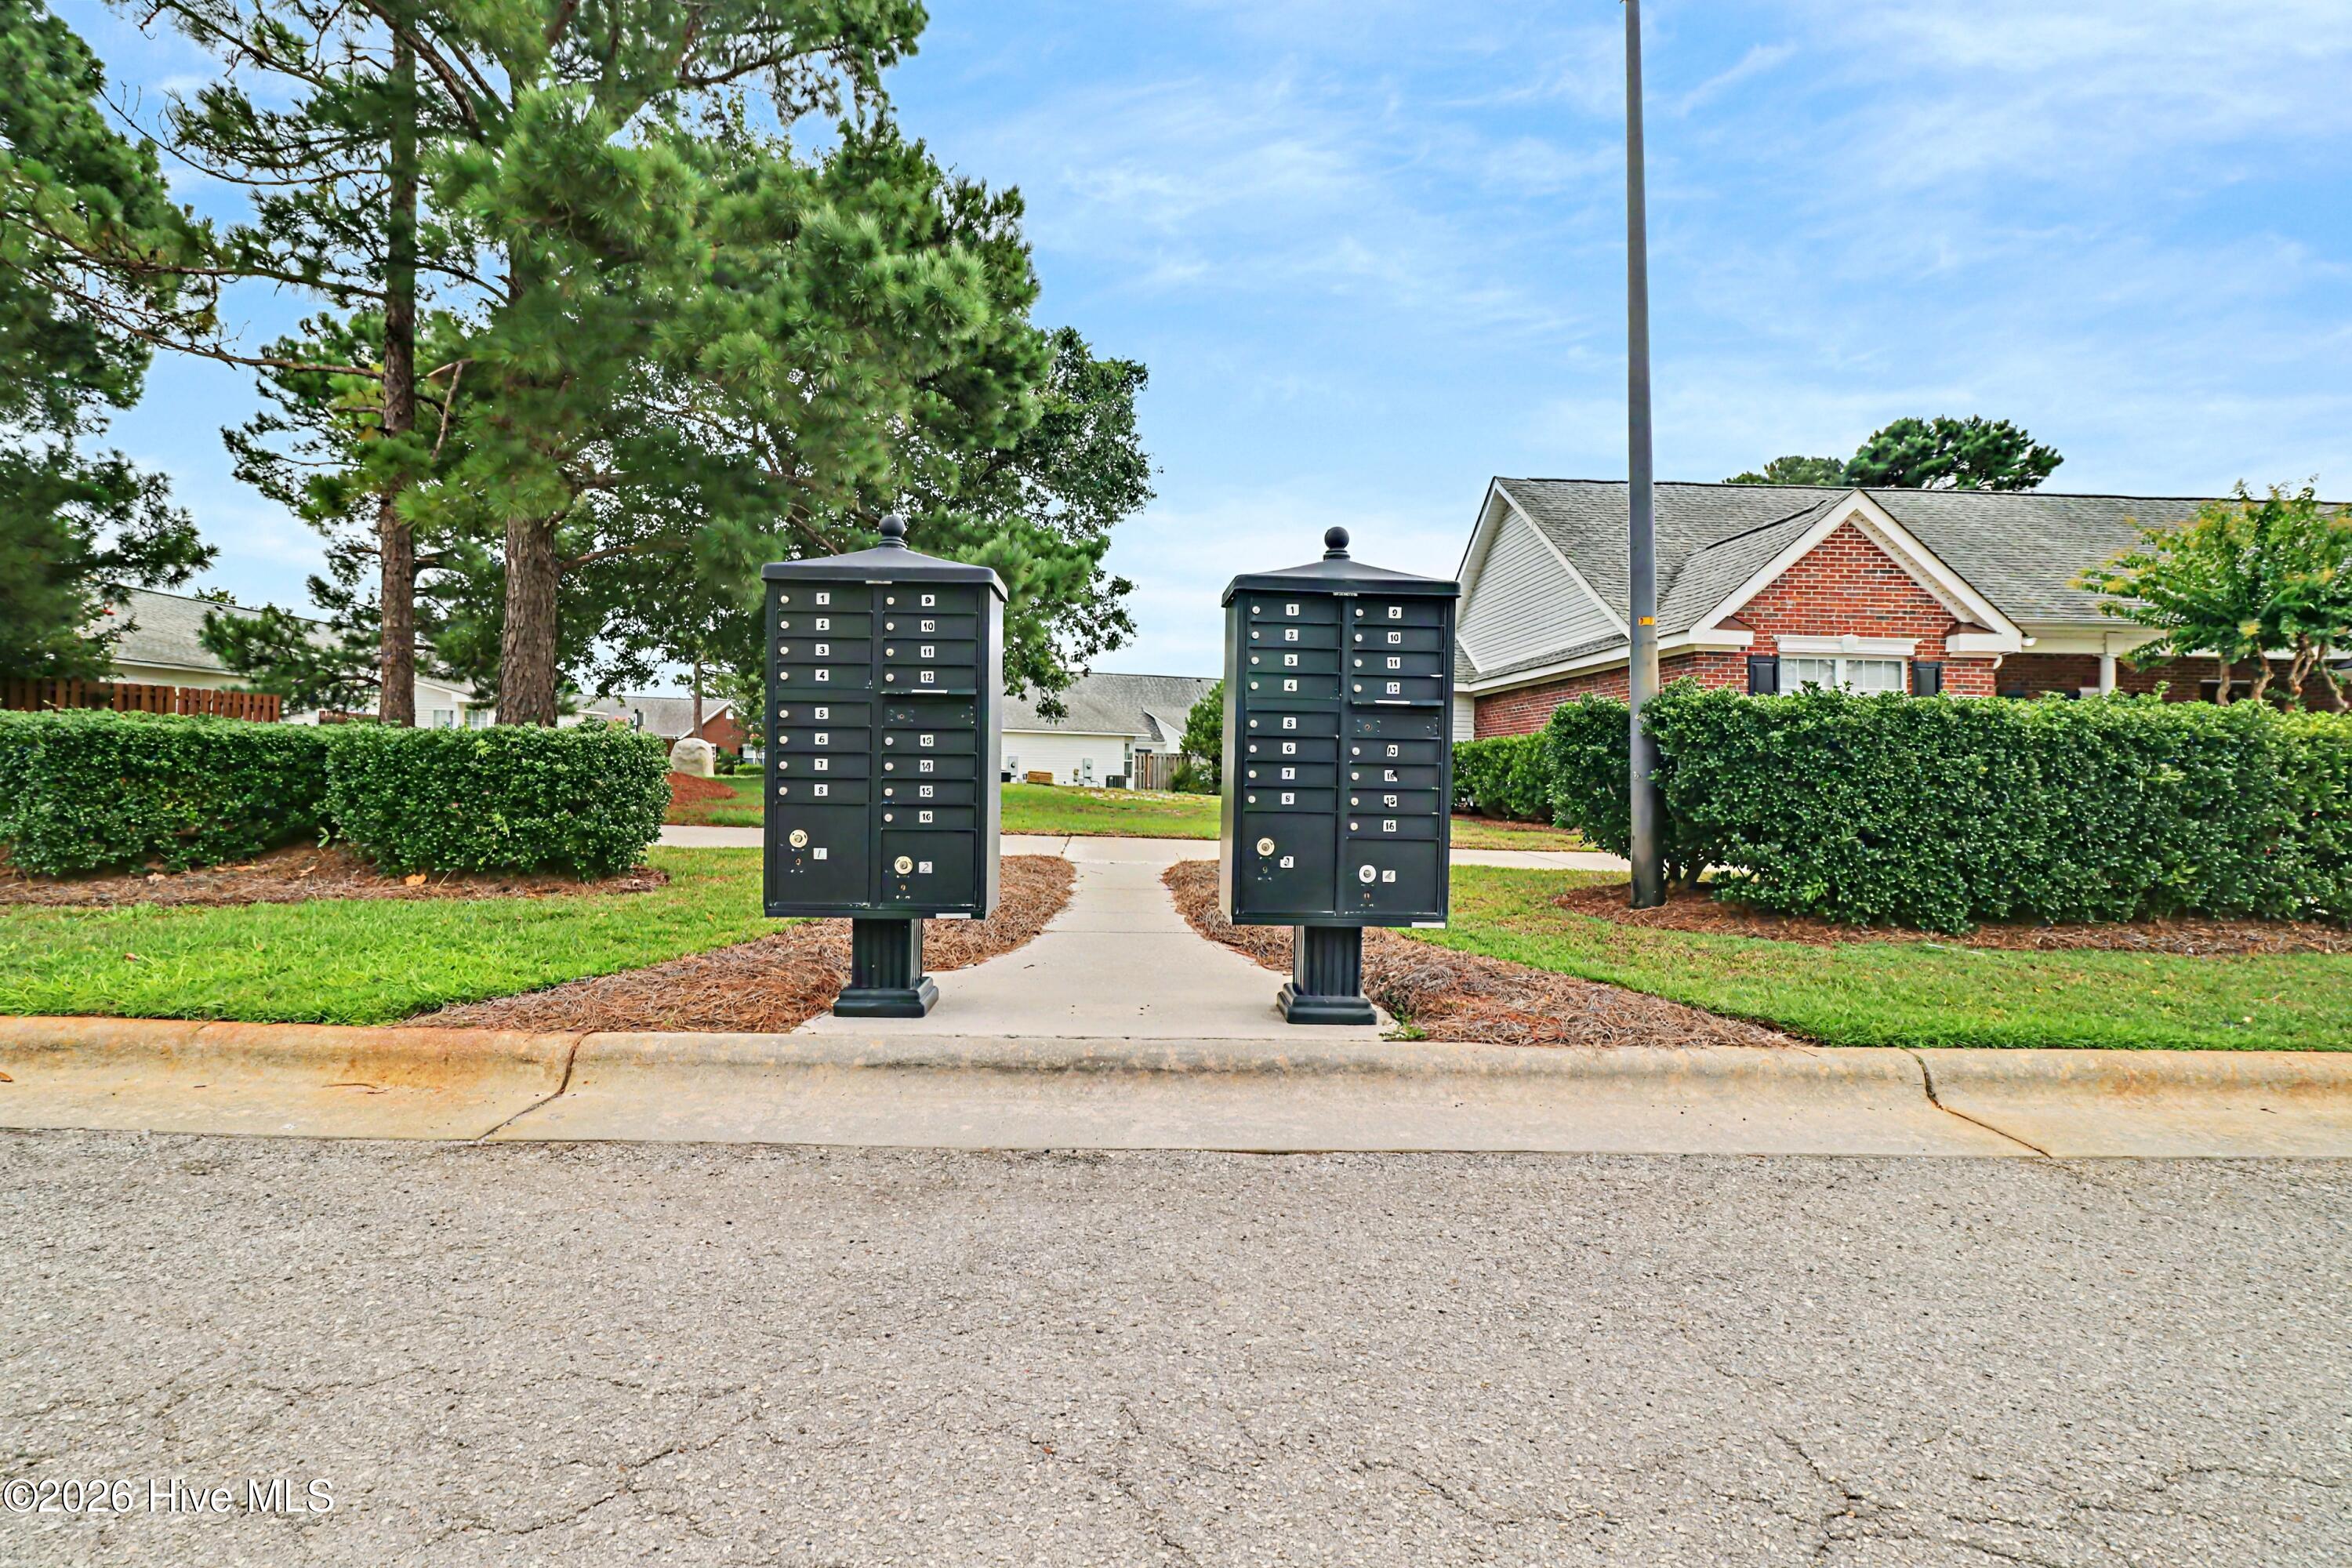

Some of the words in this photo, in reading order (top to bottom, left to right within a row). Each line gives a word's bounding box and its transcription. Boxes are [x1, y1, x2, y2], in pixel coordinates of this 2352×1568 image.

[924, 596, 932, 604] 9
[1392, 608, 1398, 617] 9
[924, 622, 934, 631] 10
[1390, 633, 1399, 642] 10
[819, 646, 826, 655] 3
[924, 648, 932, 656] 11
[1389, 659, 1398, 667] 11
[818, 671, 826, 680] 4
[923, 673, 933, 681] 12
[818, 710, 825, 718] 5
[1287, 719, 1293, 728] 5
[1286, 744, 1292, 753] 6
[818, 786, 824, 795] 8
[921, 787, 931, 796] 15
[1385, 822, 1395, 830] 16
[921, 862, 929, 872] 2
